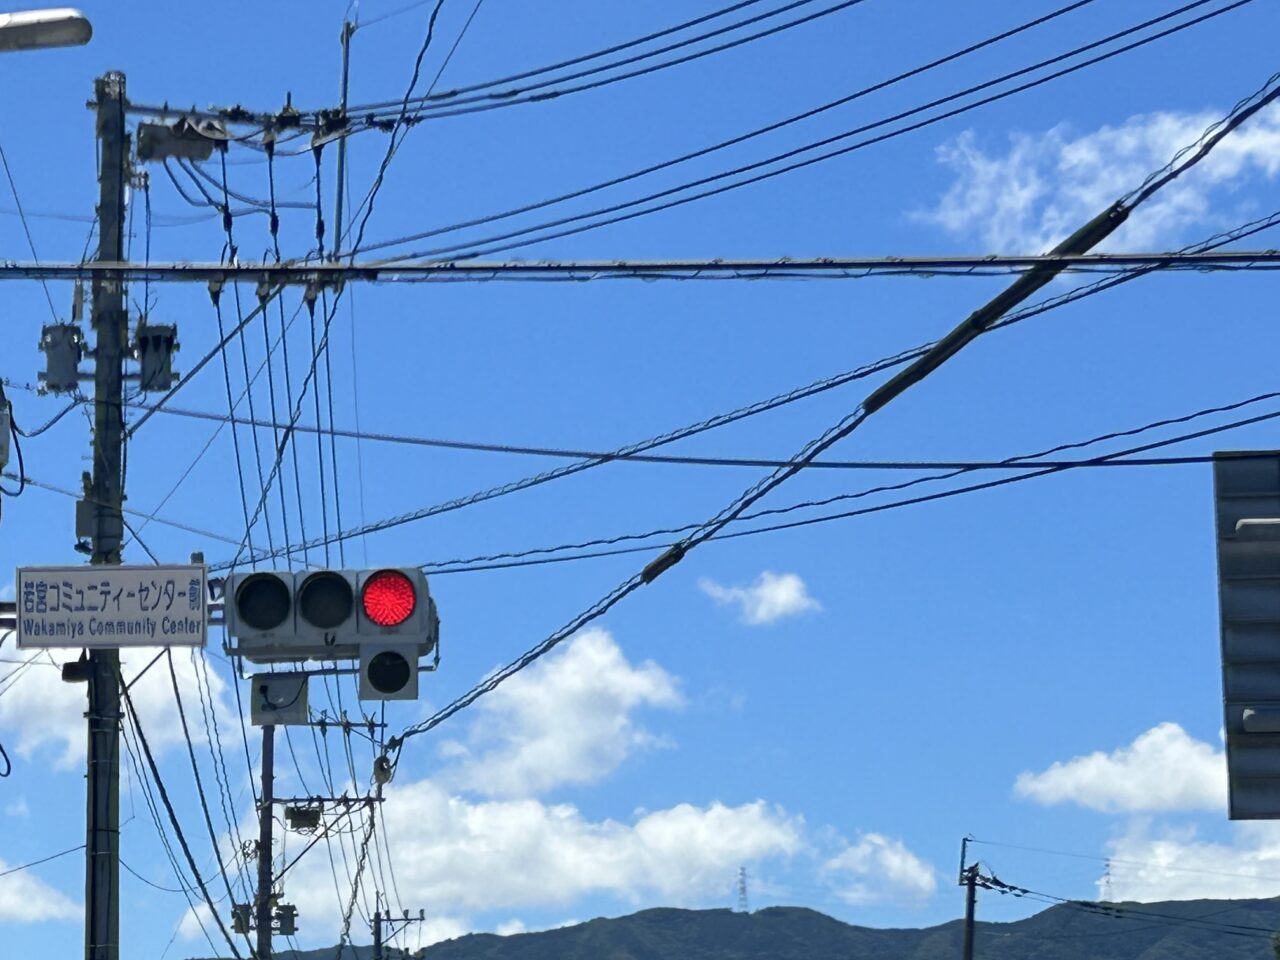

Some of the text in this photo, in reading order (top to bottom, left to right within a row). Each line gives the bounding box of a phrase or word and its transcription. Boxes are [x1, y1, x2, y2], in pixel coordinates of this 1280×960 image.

[23, 615, 202, 639] Wakamiya Community Center
